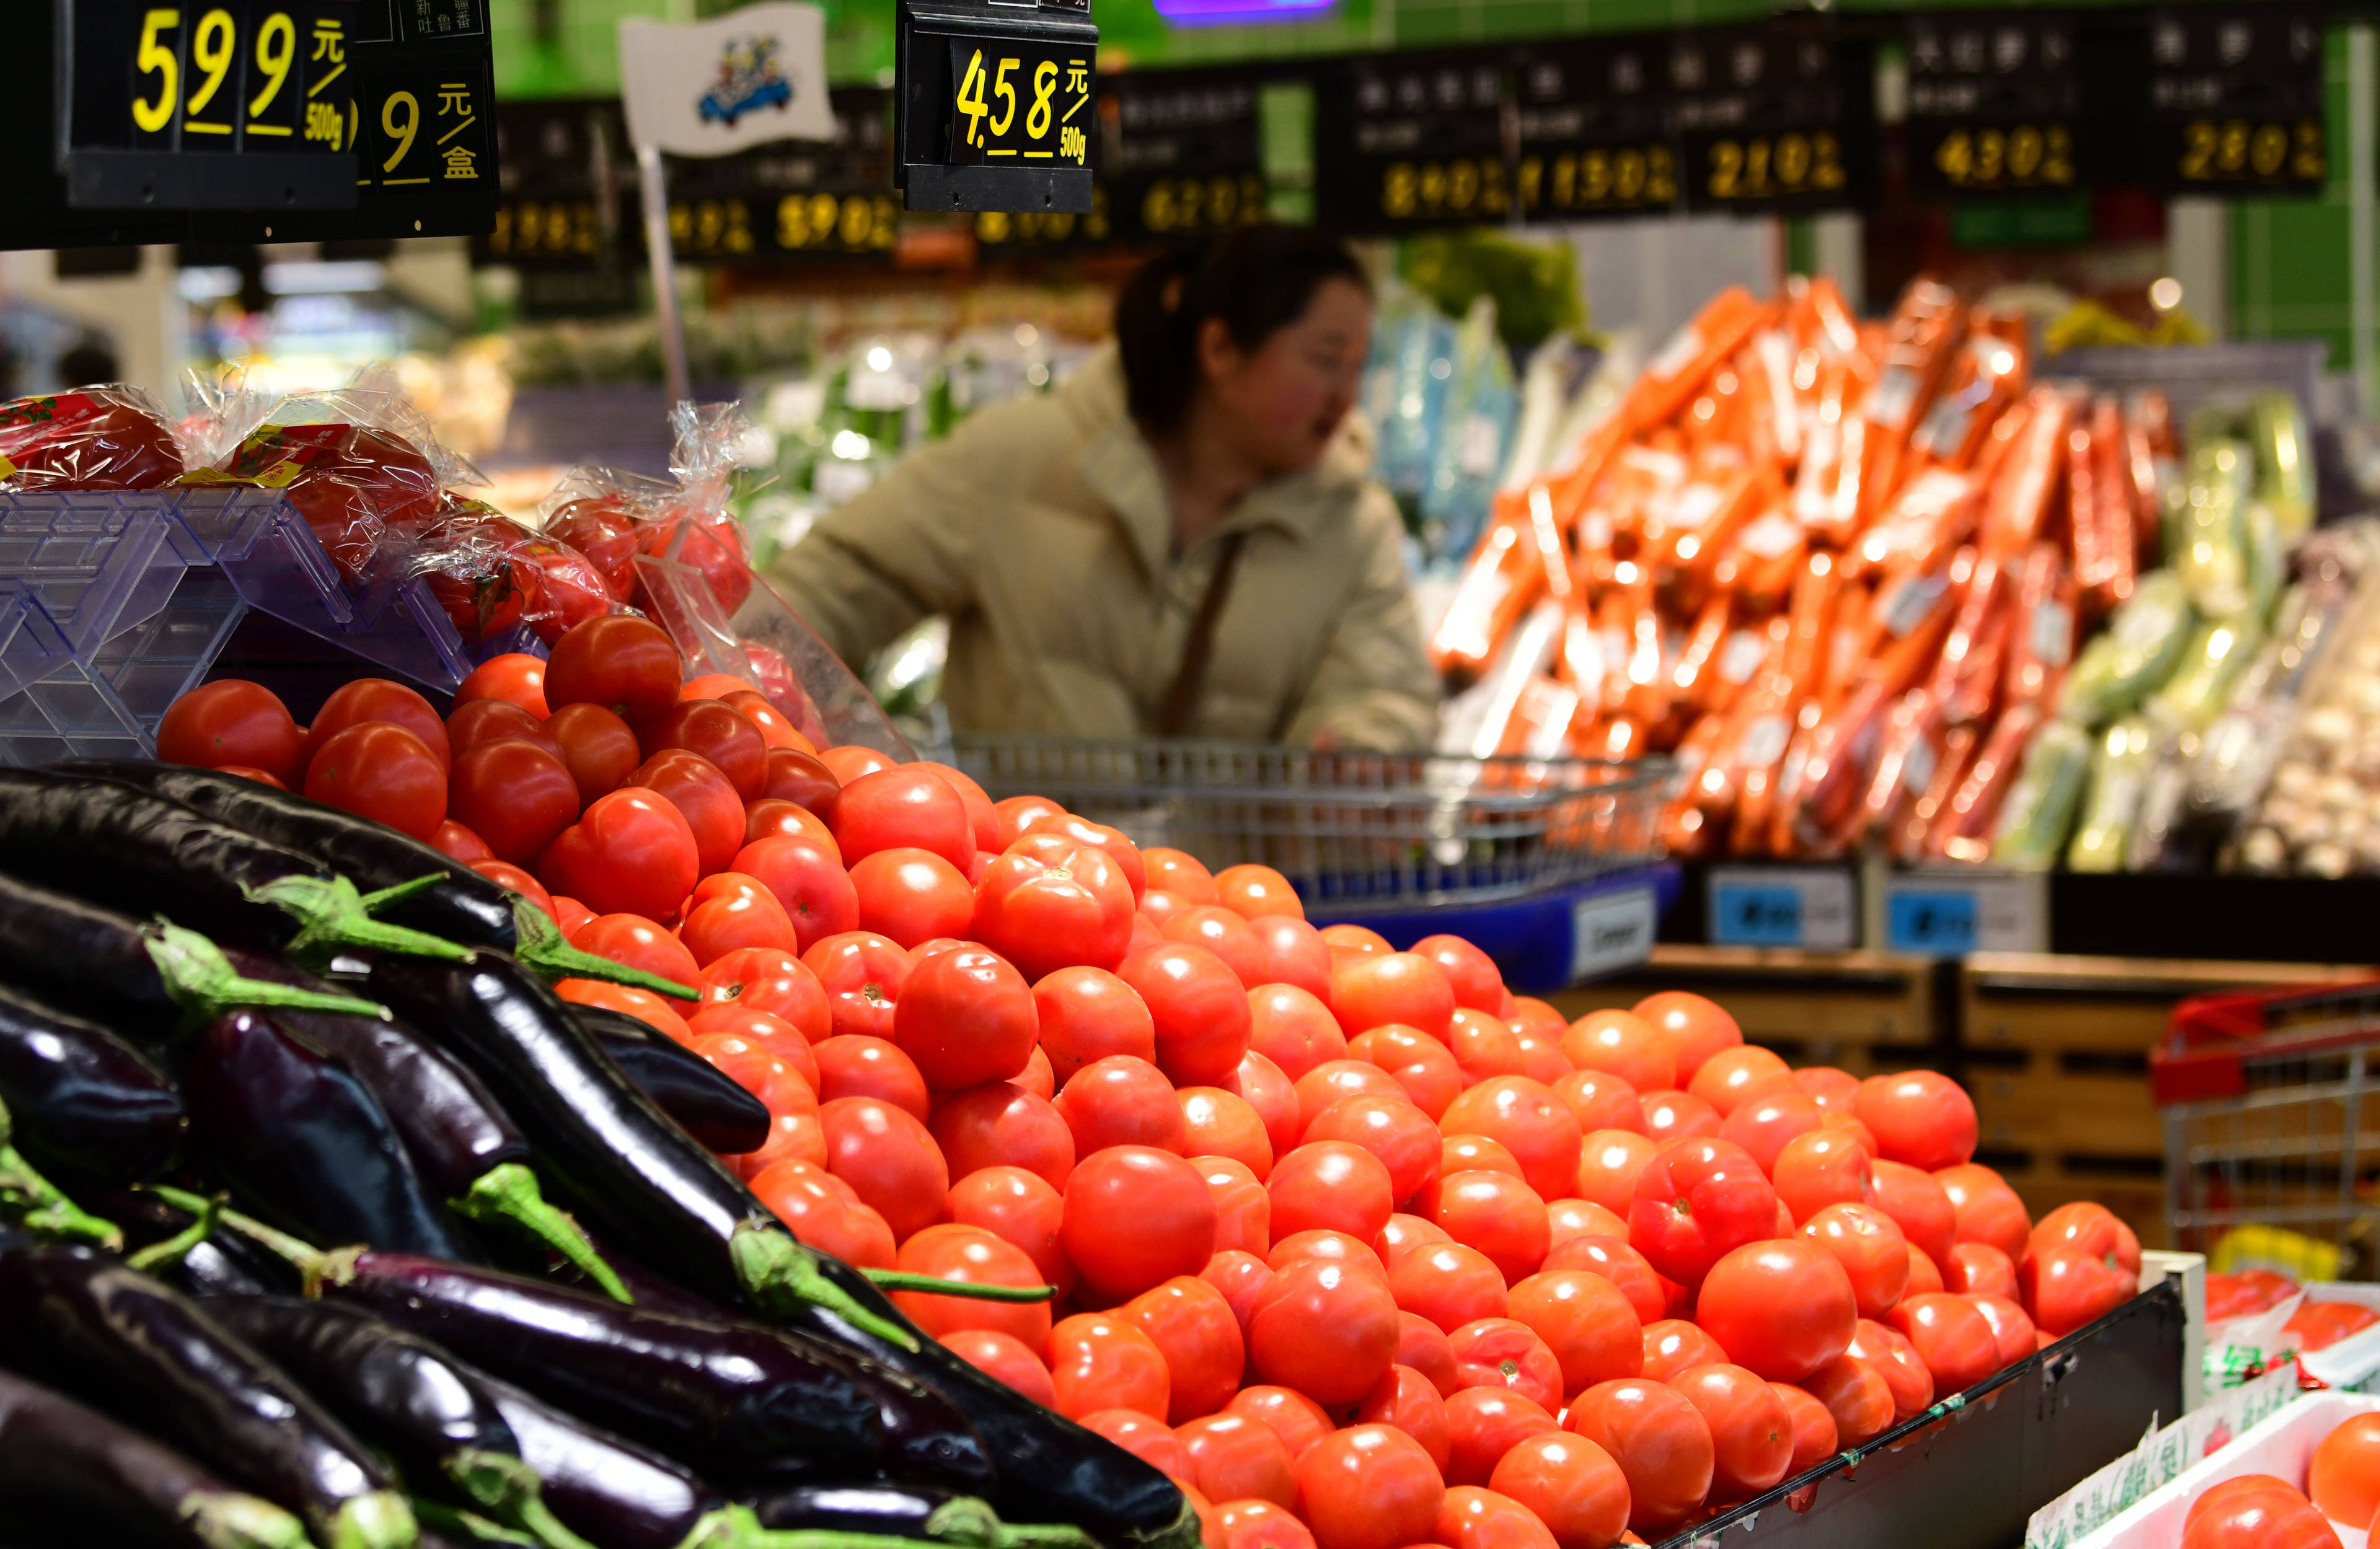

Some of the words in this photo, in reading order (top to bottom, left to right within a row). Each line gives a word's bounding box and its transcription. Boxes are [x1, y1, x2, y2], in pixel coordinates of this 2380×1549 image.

[418, 11, 471, 33] 吐鲁番
[305, 101, 343, 152] 500g
[1059, 126, 1087, 166] 500g
